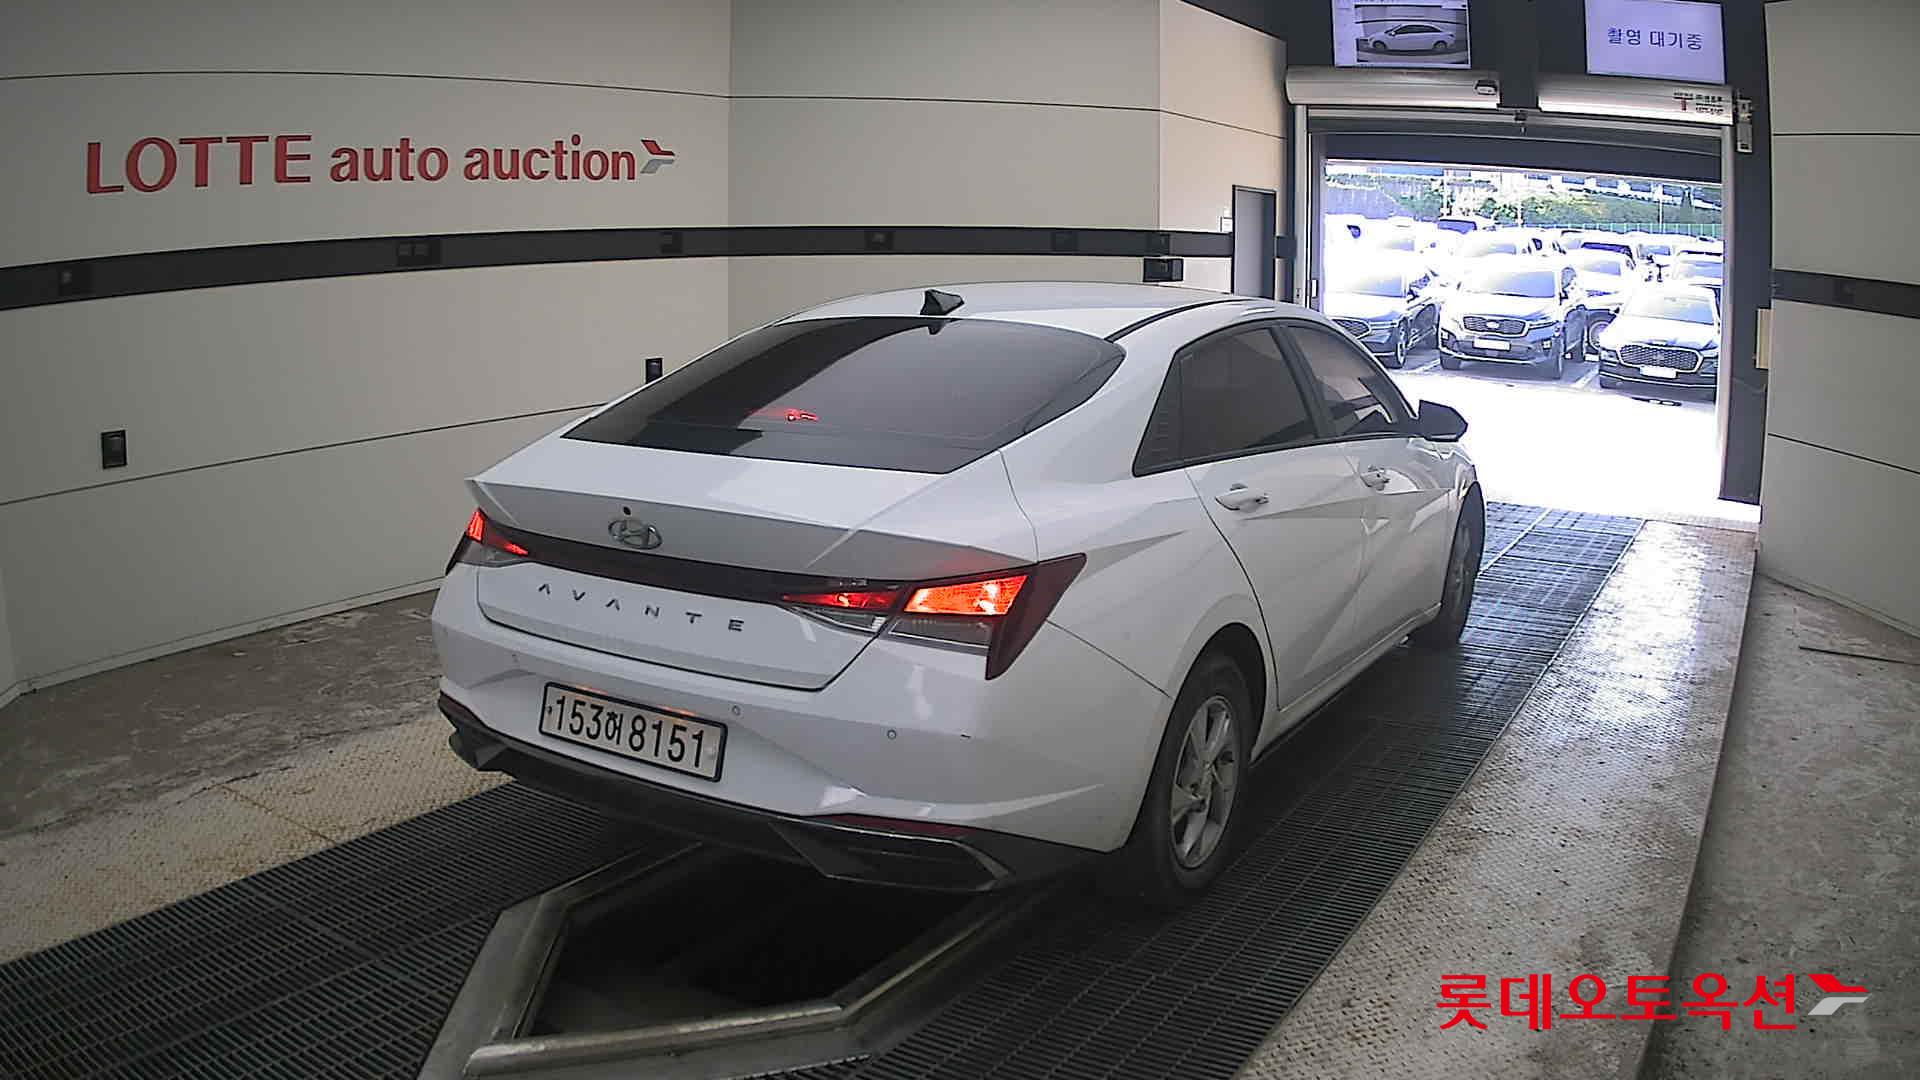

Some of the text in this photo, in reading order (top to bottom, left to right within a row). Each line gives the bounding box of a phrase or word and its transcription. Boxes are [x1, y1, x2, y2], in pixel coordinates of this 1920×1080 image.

[1608, 27, 1641, 46] 촬영
[86, 134, 637, 194] LOTTE auto auction
[537, 583, 745, 632] AVANTE
